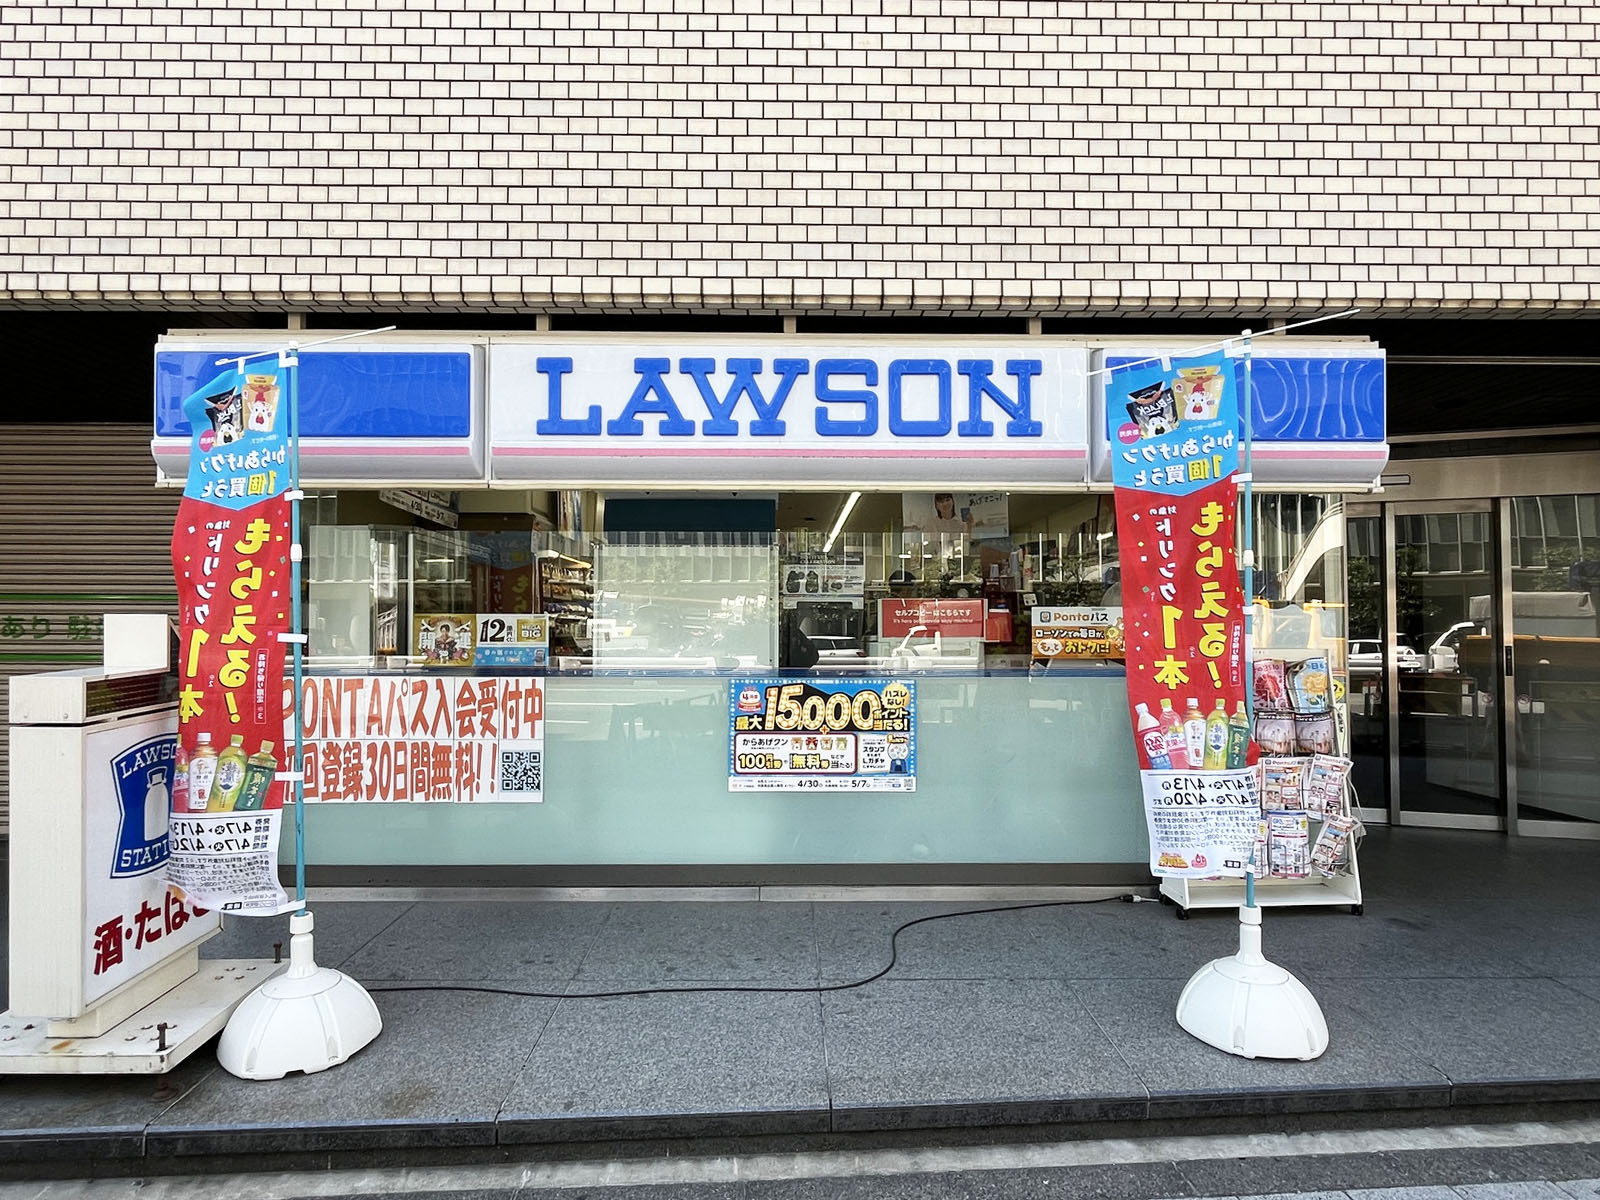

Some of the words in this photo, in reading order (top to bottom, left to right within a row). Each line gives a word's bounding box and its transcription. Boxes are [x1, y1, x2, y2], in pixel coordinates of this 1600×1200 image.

[536, 357, 1043, 437] LAWSON
[1053, 612, 1109, 622] Pontaパス
[1, 616, 53, 639] あり
[480, 618, 506, 642] 12
[521, 630, 541, 638] BIG
[1040, 641, 1060, 653] もっと
[1065, 641, 1110, 653] おトクに!
[885, 689, 907, 697] ハズレ
[765, 683, 881, 731] 15,000
[887, 698, 905, 706] なし!
[735, 715, 763, 730] 最大
[873, 719, 909, 731] 当たる!
[742, 738, 788, 746] からあげクン
[831, 760, 853, 769] 当たる!
[797, 780, 819, 788] 4/30
[851, 780, 867, 788] 5/7
